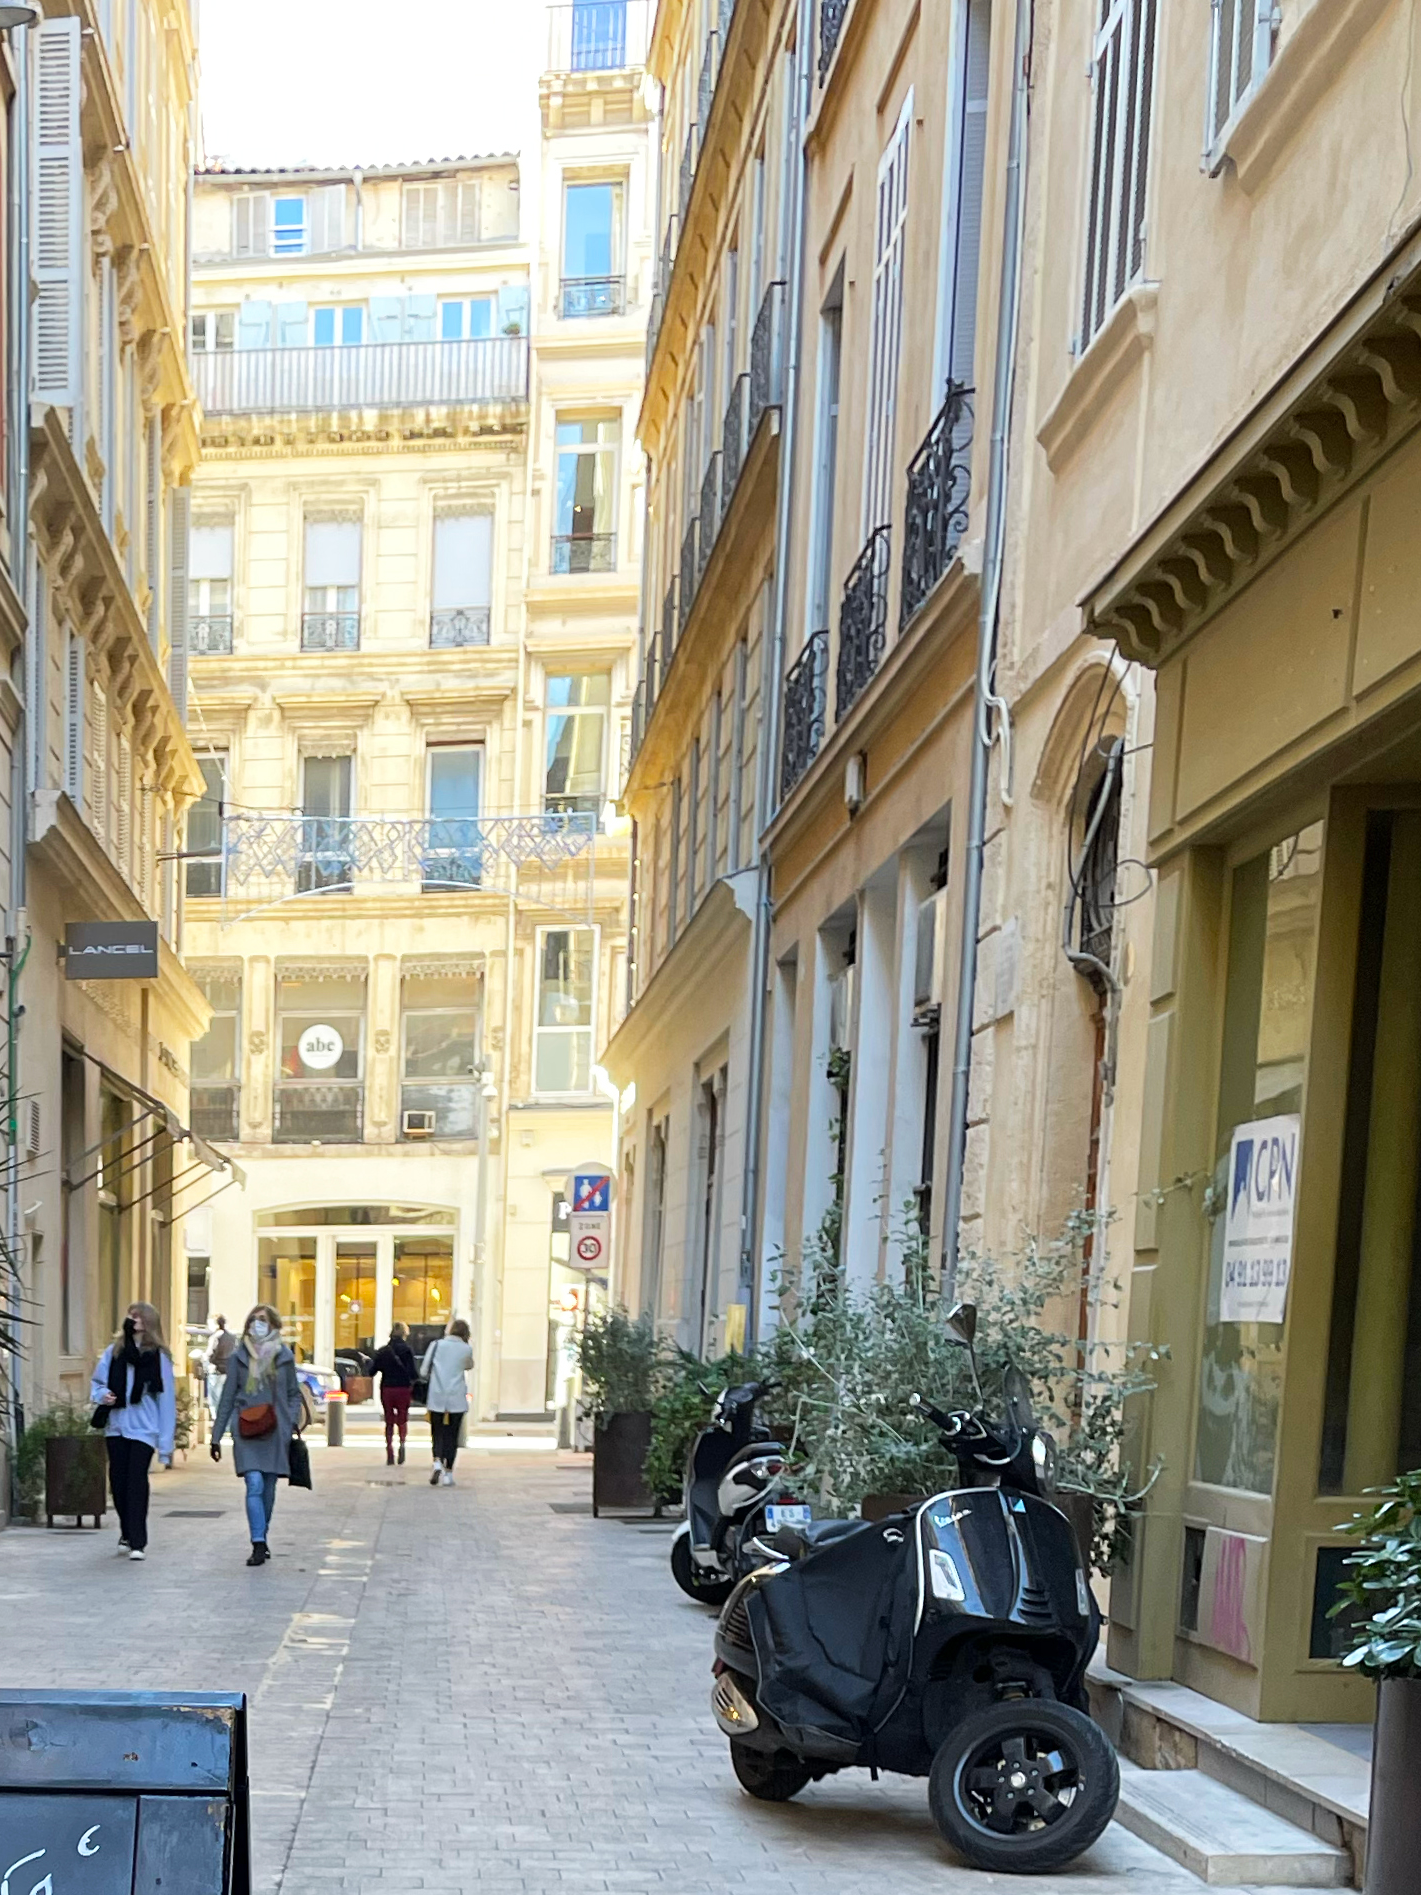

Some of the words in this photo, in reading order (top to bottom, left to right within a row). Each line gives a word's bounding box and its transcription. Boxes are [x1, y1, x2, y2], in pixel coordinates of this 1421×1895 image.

[68, 944, 155, 955] LANCEL
[306, 1037, 336, 1052] abc
[1254, 1132, 1296, 1203] CPN
[582, 1242, 597, 1254] 30
